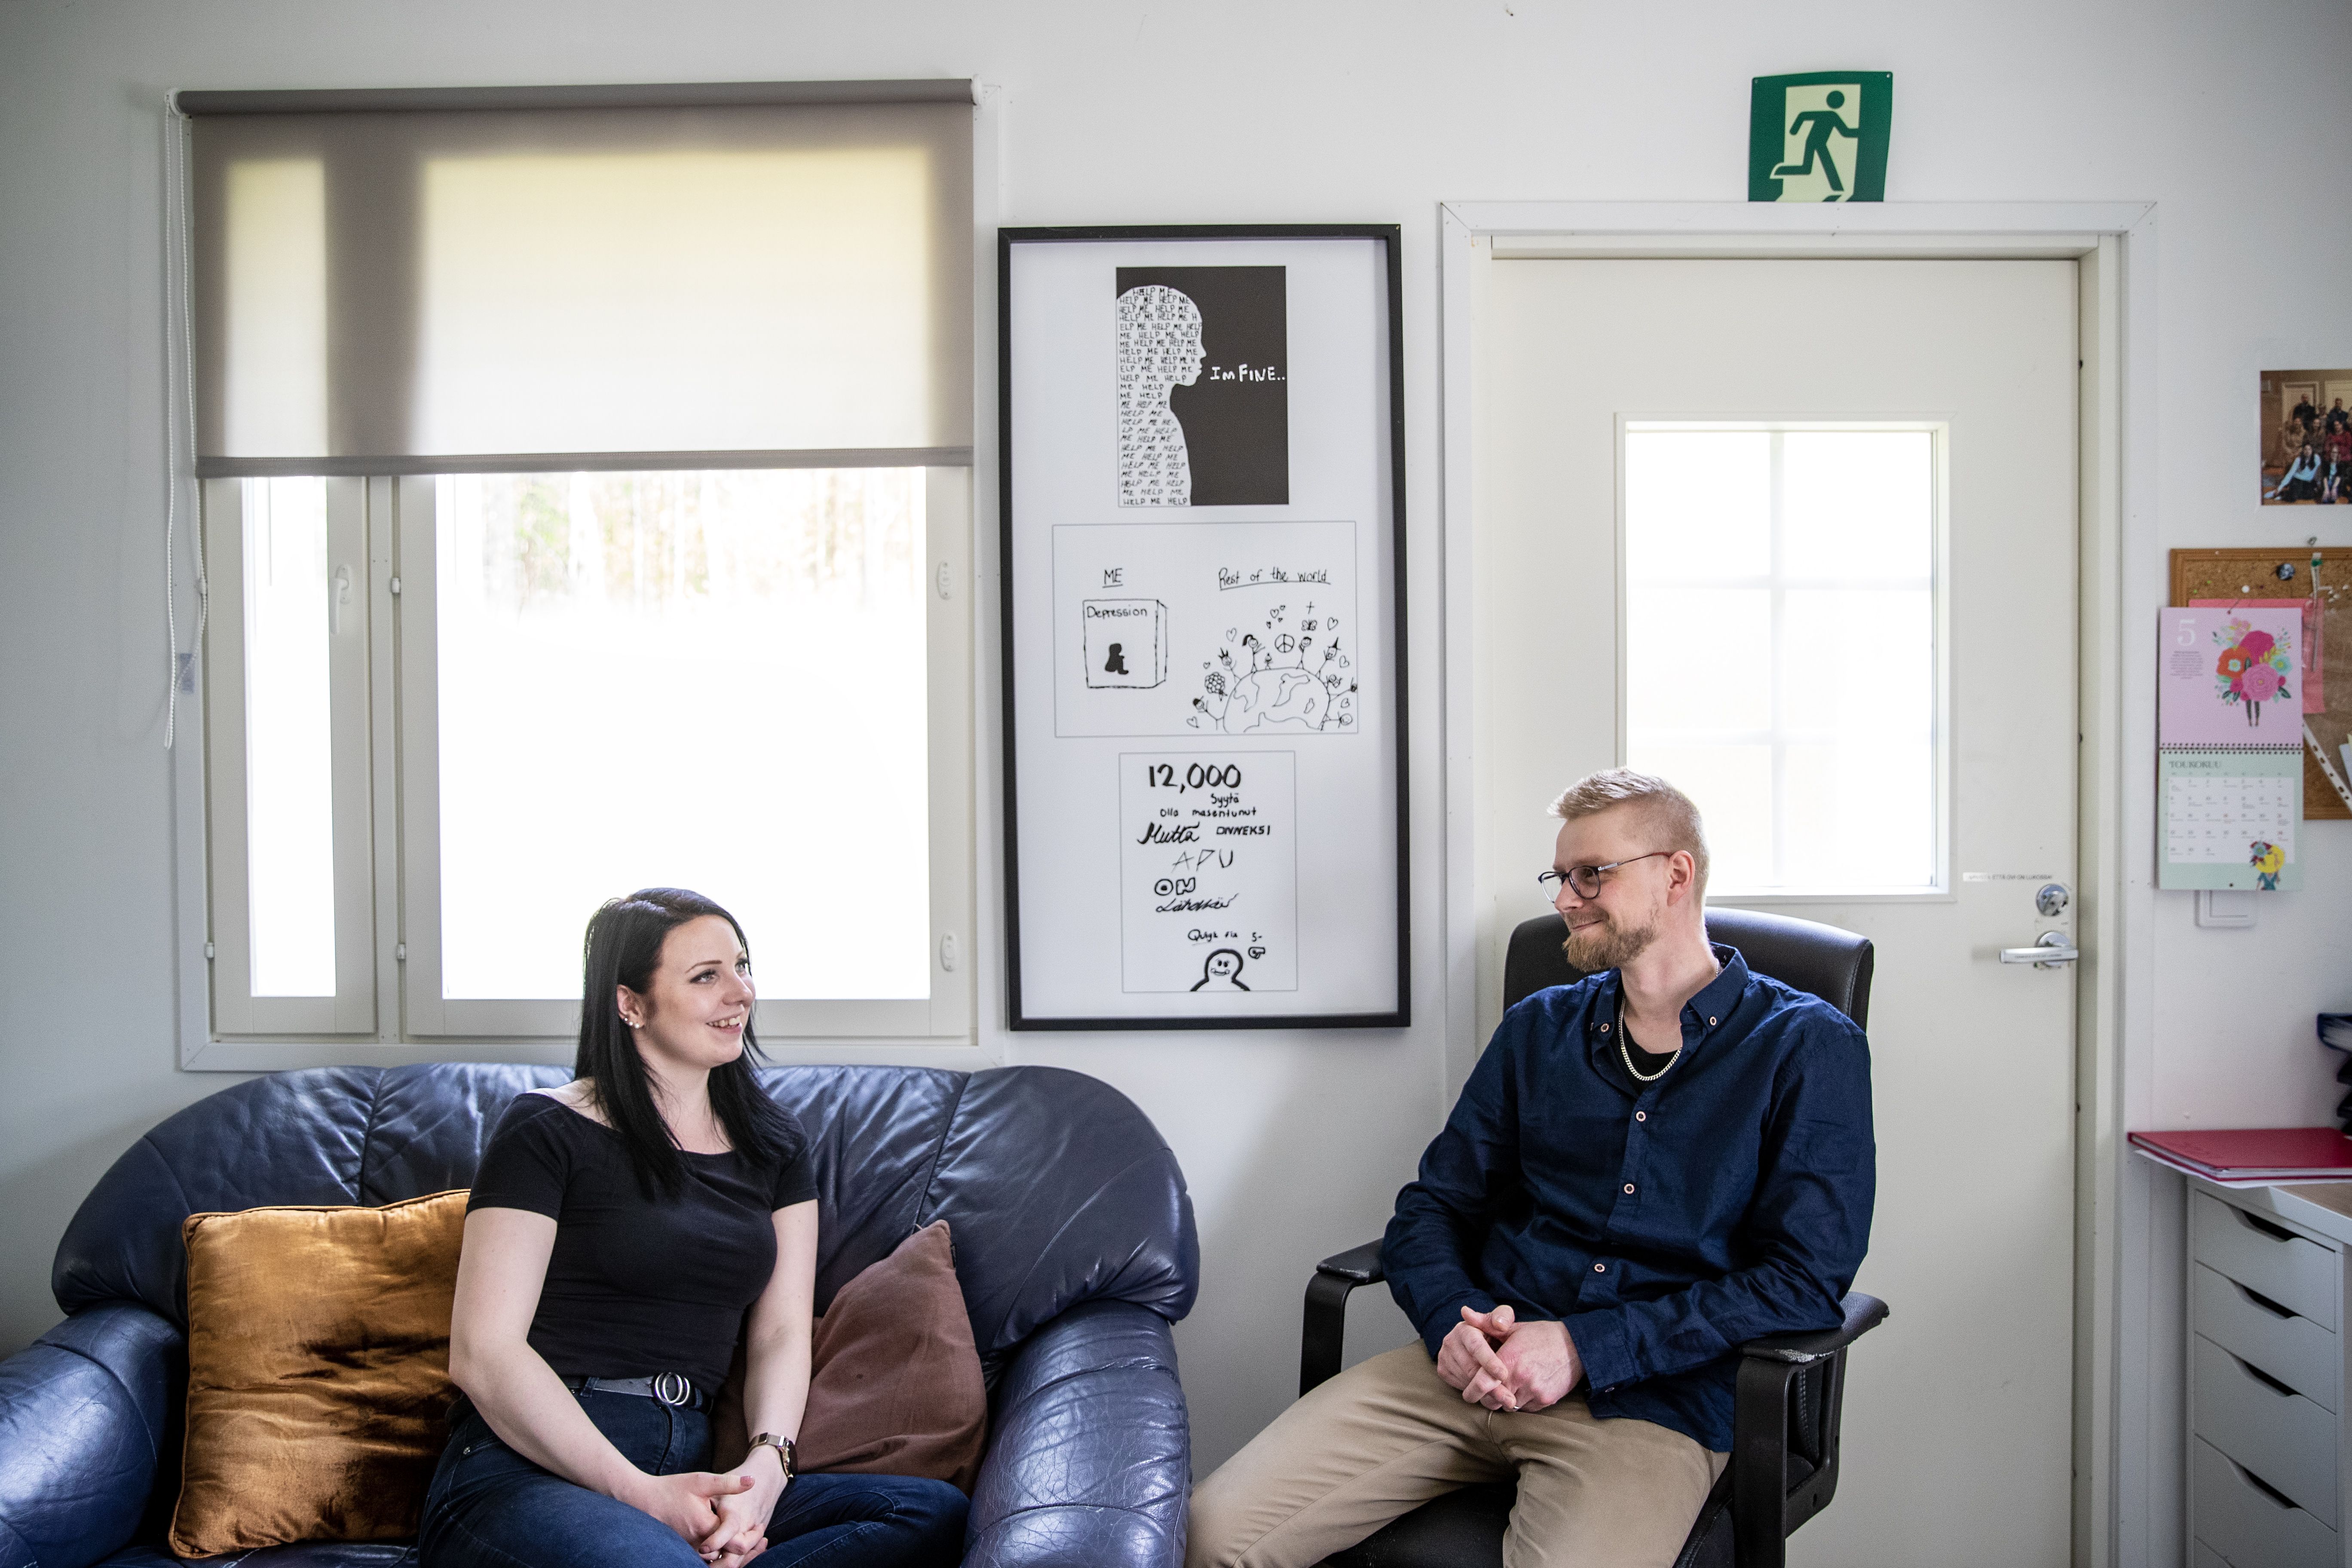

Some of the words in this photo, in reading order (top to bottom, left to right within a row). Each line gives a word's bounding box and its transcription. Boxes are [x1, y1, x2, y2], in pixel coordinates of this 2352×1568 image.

[1144, 297, 1153, 305] ME
[1179, 296, 1190, 304] ME
[1140, 305, 1149, 313] ME
[1210, 366, 1235, 380] Im
[1121, 401, 1130, 409] ME
[1104, 567, 1123, 584] ME
[1219, 567, 1240, 590] Rest
[1250, 569, 1263, 581] of
[1270, 566, 1289, 582] the
[1298, 569, 1327, 582] world
[1087, 604, 1147, 620] Depression
[2177, 618, 2197, 646] 5
[1149, 763, 1241, 794] 12,000
[1210, 793, 1239, 808] Syytä
[1137, 821, 1200, 845] Mutta
[1216, 825, 1271, 835] ONNEKSI
[1170, 848, 1233, 873] APU
